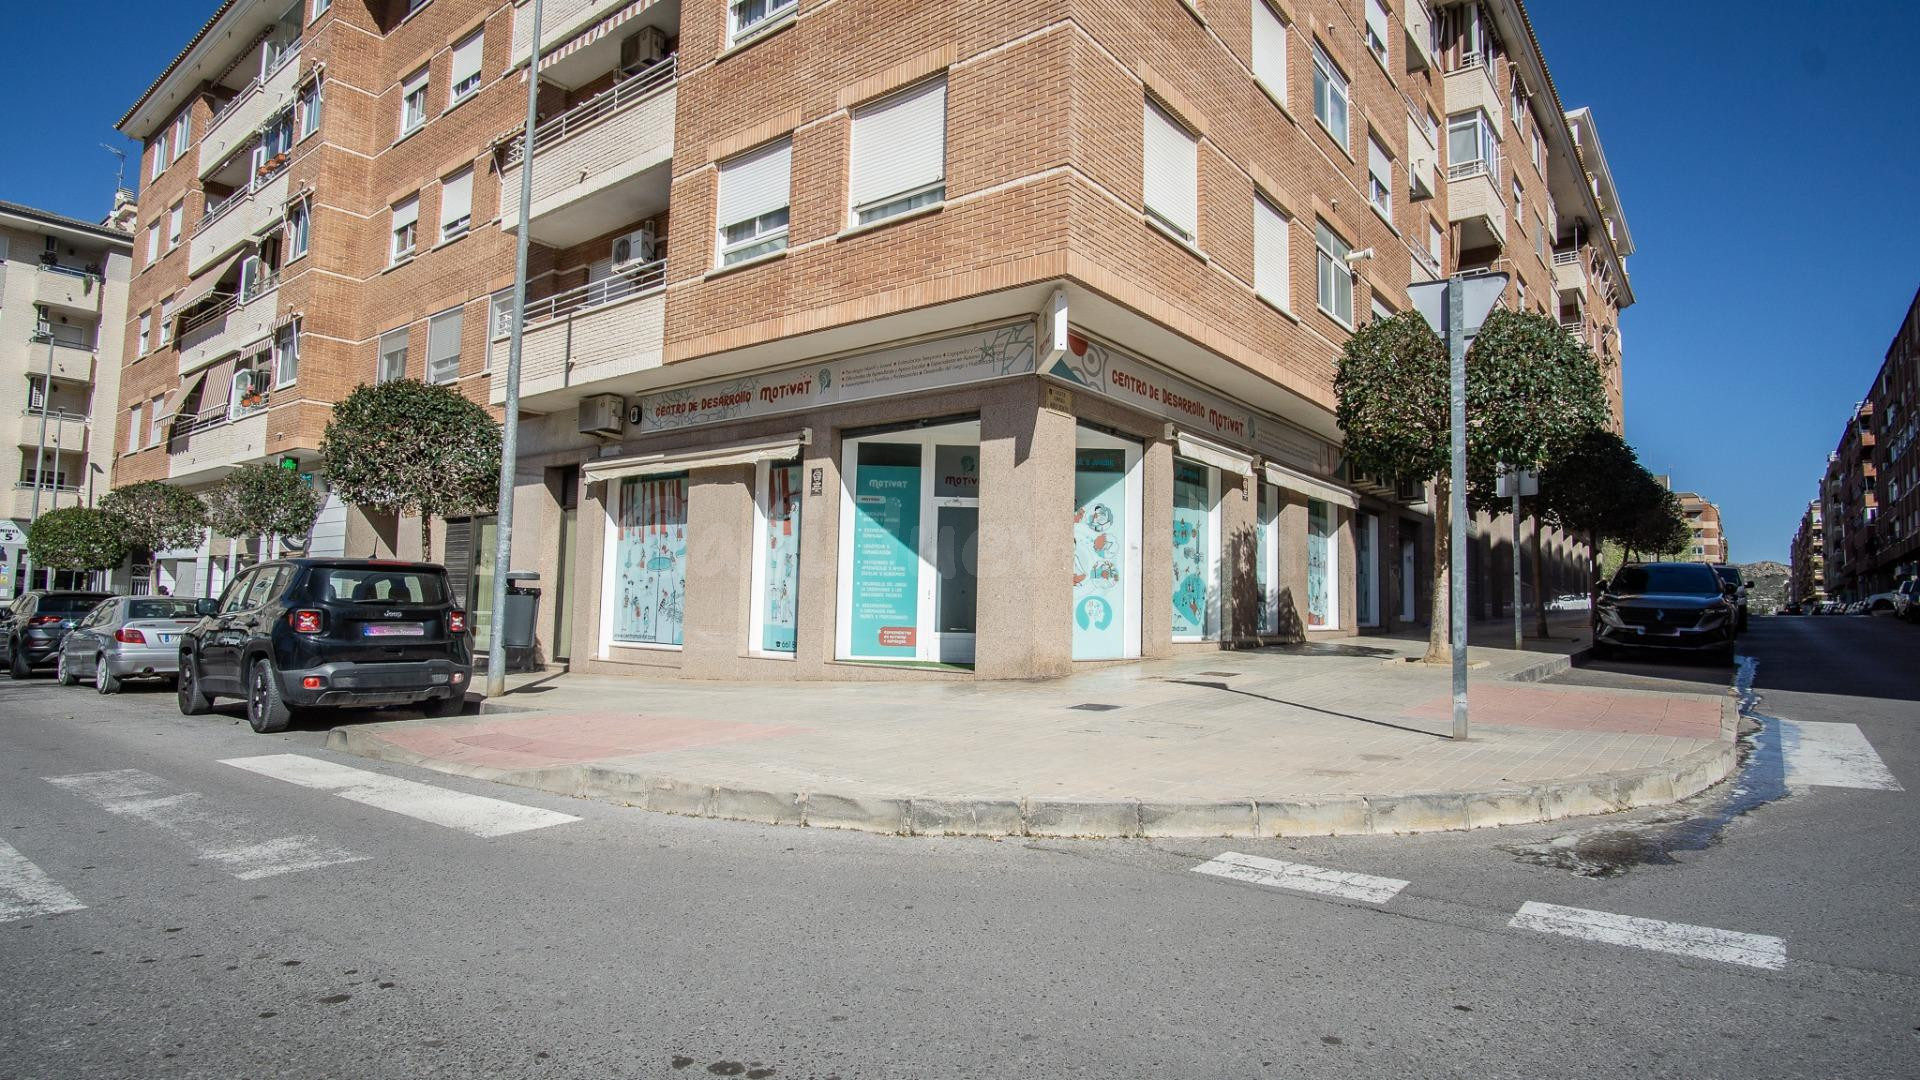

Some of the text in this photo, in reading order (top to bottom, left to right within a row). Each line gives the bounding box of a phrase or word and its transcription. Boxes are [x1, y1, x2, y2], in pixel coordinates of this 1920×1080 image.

[1112, 369, 1147, 396] CENTRO
[1149, 385, 1159, 400] DE
[656, 403, 686, 417] CENTRO
[688, 402, 698, 413] DE
[384, 610, 402, 618] Jeep
